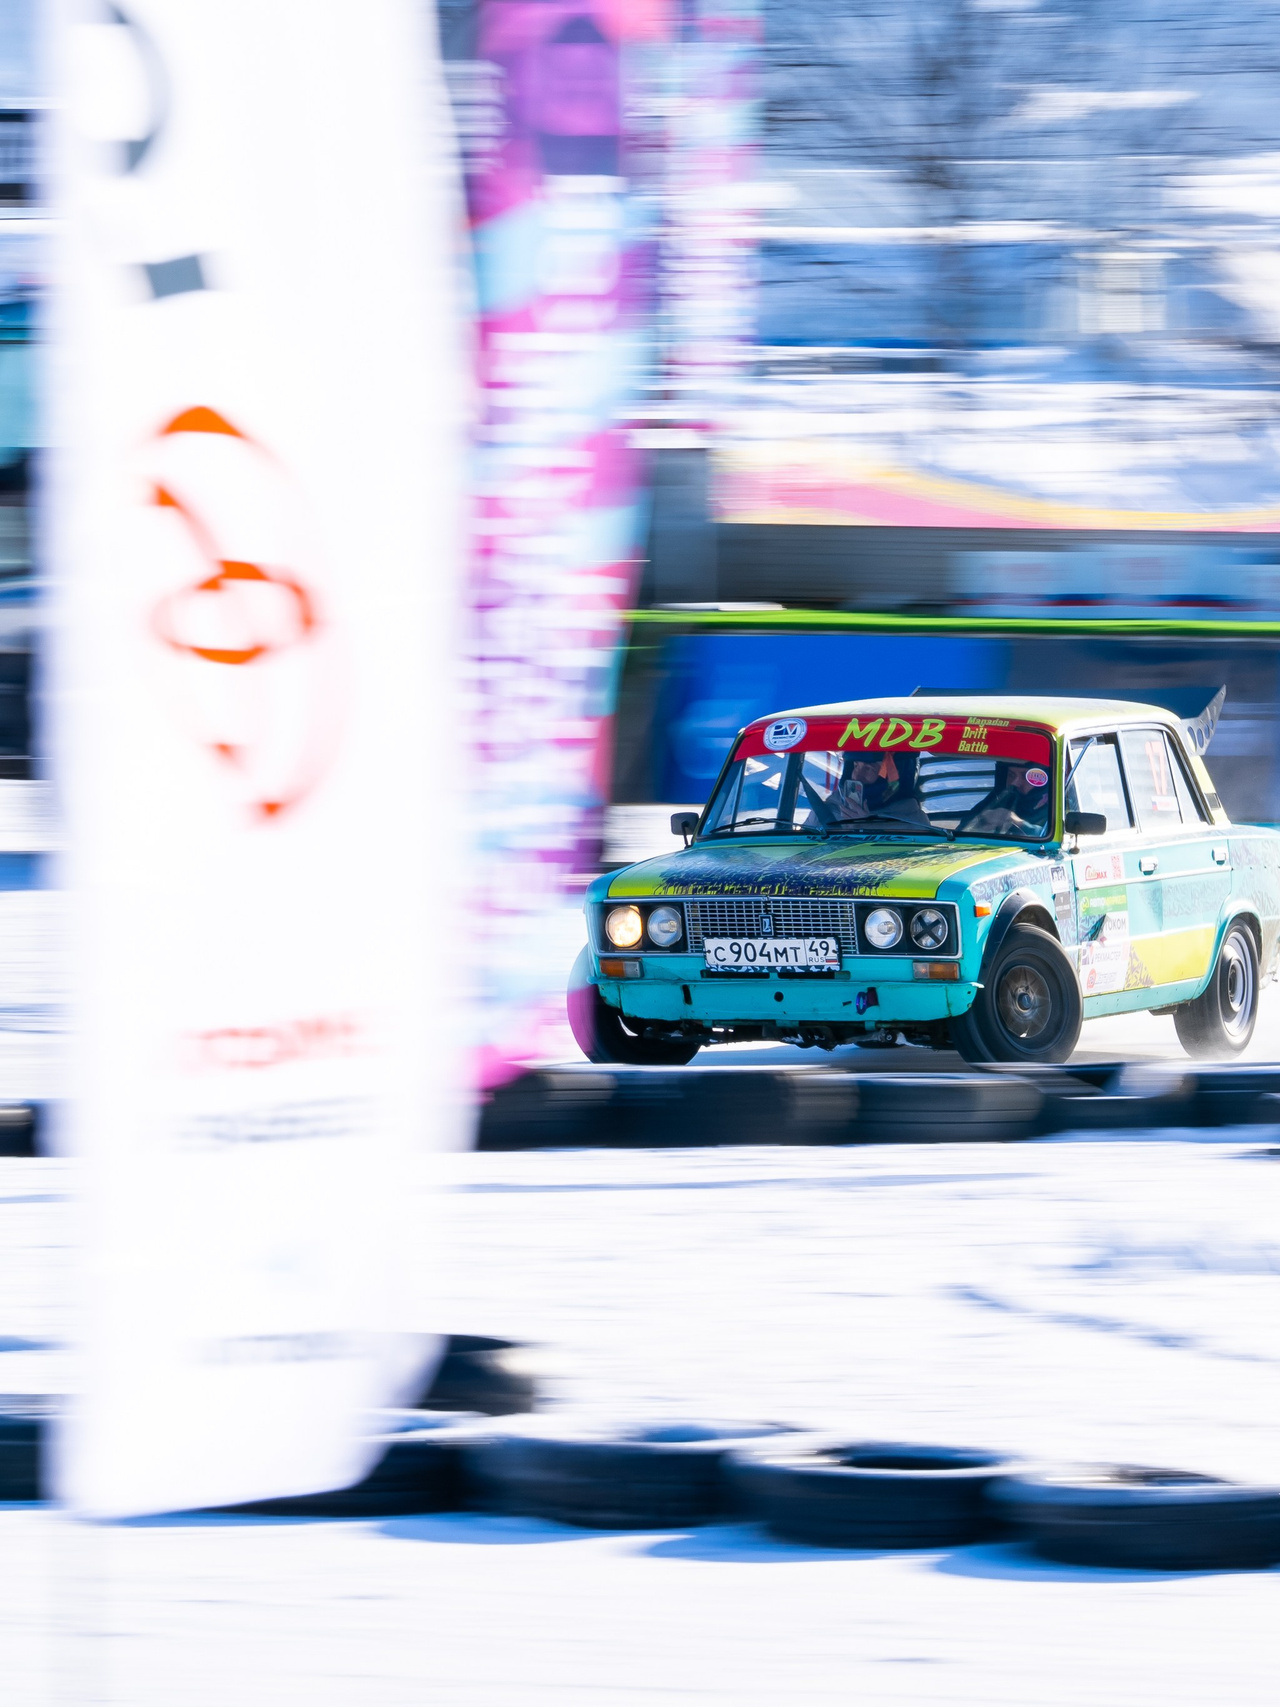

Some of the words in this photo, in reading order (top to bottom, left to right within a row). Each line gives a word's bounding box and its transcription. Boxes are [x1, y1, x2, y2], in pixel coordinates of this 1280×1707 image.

[837, 718, 946, 748] MDB
[962, 726, 988, 740] Drift
[958, 740, 989, 753] Battle
[1105, 918, 1127, 932] ТОКОМ
[808, 940, 830, 957] 49
